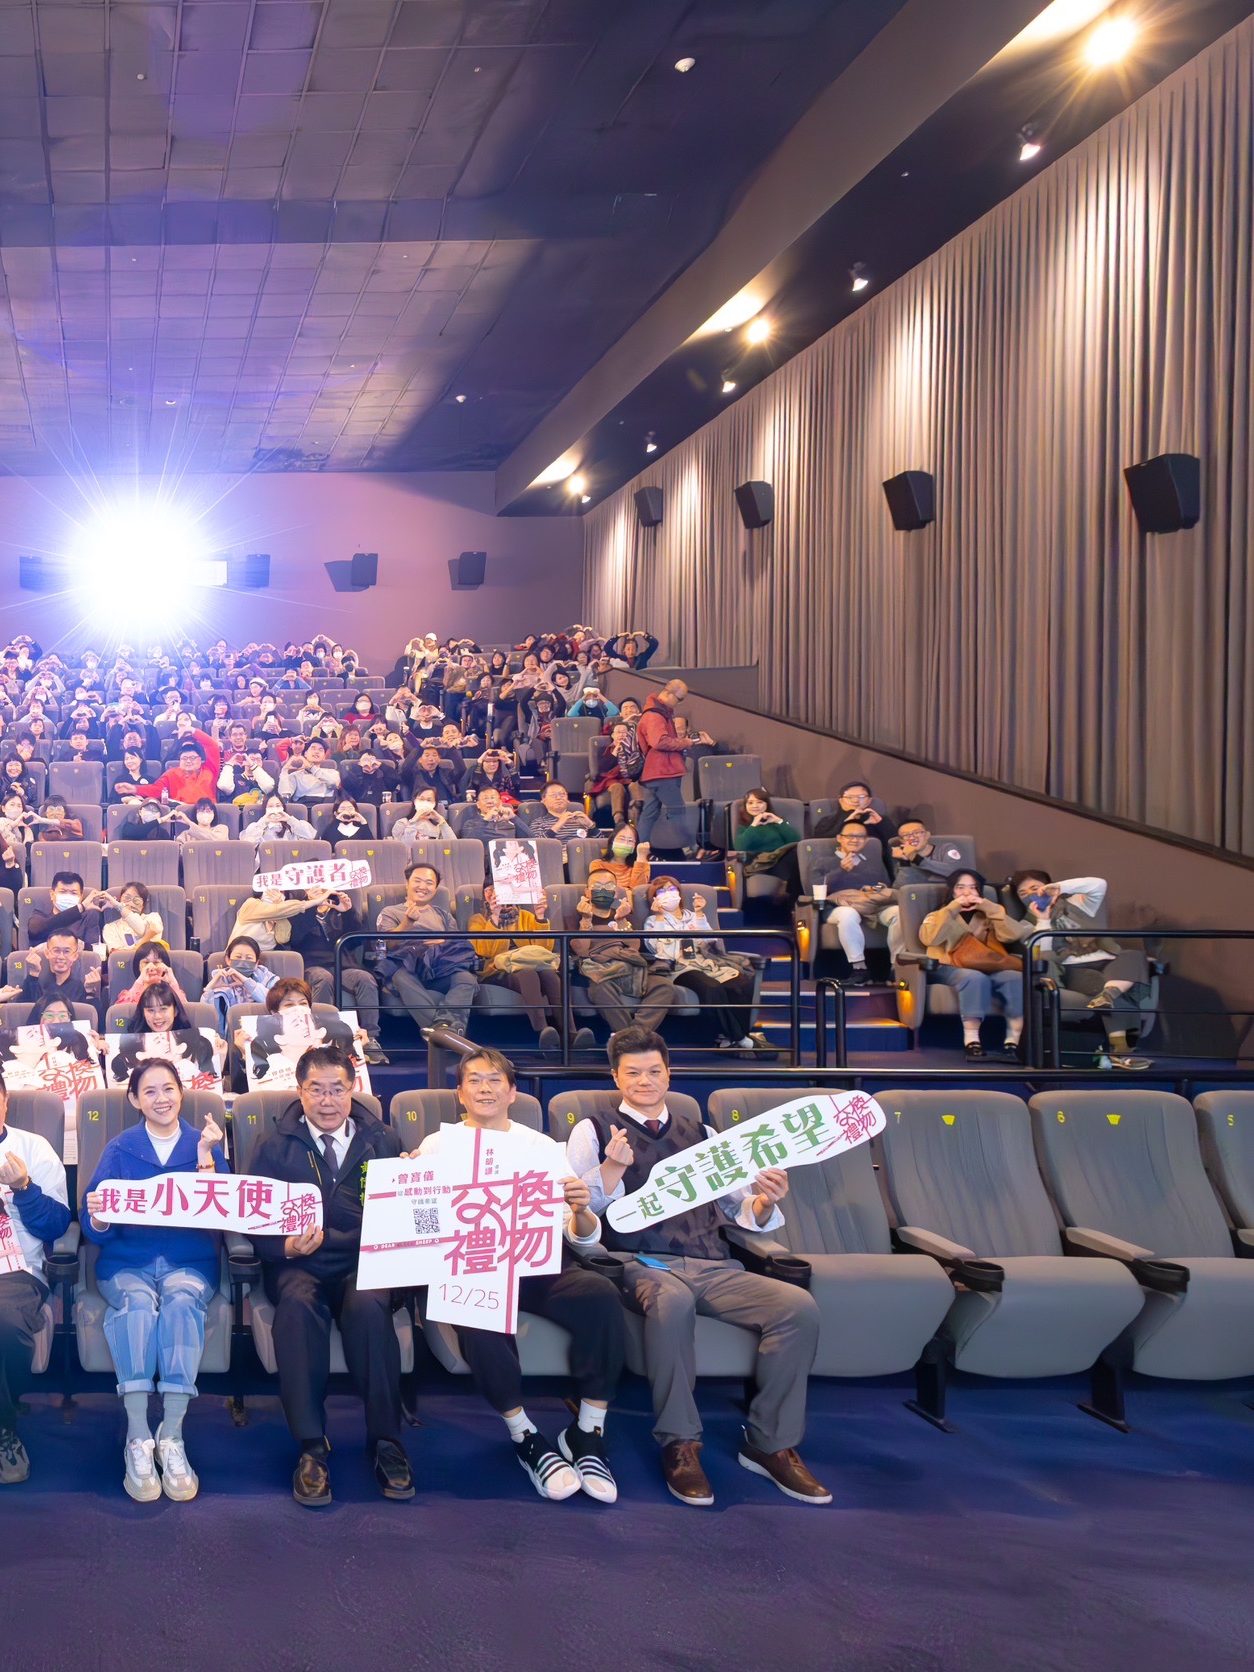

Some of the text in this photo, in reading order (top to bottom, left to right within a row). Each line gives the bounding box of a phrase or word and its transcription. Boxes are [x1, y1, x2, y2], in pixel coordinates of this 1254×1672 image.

[257, 863, 346, 888] 我是守護者
[115, 1018, 124, 1026] 12
[38, 1059, 94, 1082] 交換
[88, 1111, 99, 1121] 12
[247, 1115, 257, 1125] 11
[406, 1111, 417, 1121] 10
[616, 1102, 837, 1222] 一起守護希望
[398, 1170, 434, 1184] 曾寶儀
[98, 1177, 274, 1220] 我是小天使
[280, 1193, 317, 1217] 交換
[451, 1169, 555, 1224] 交換
[279, 1211, 316, 1234] 禮物
[444, 1222, 554, 1276] 禮物
[439, 1283, 500, 1310] 12/25
